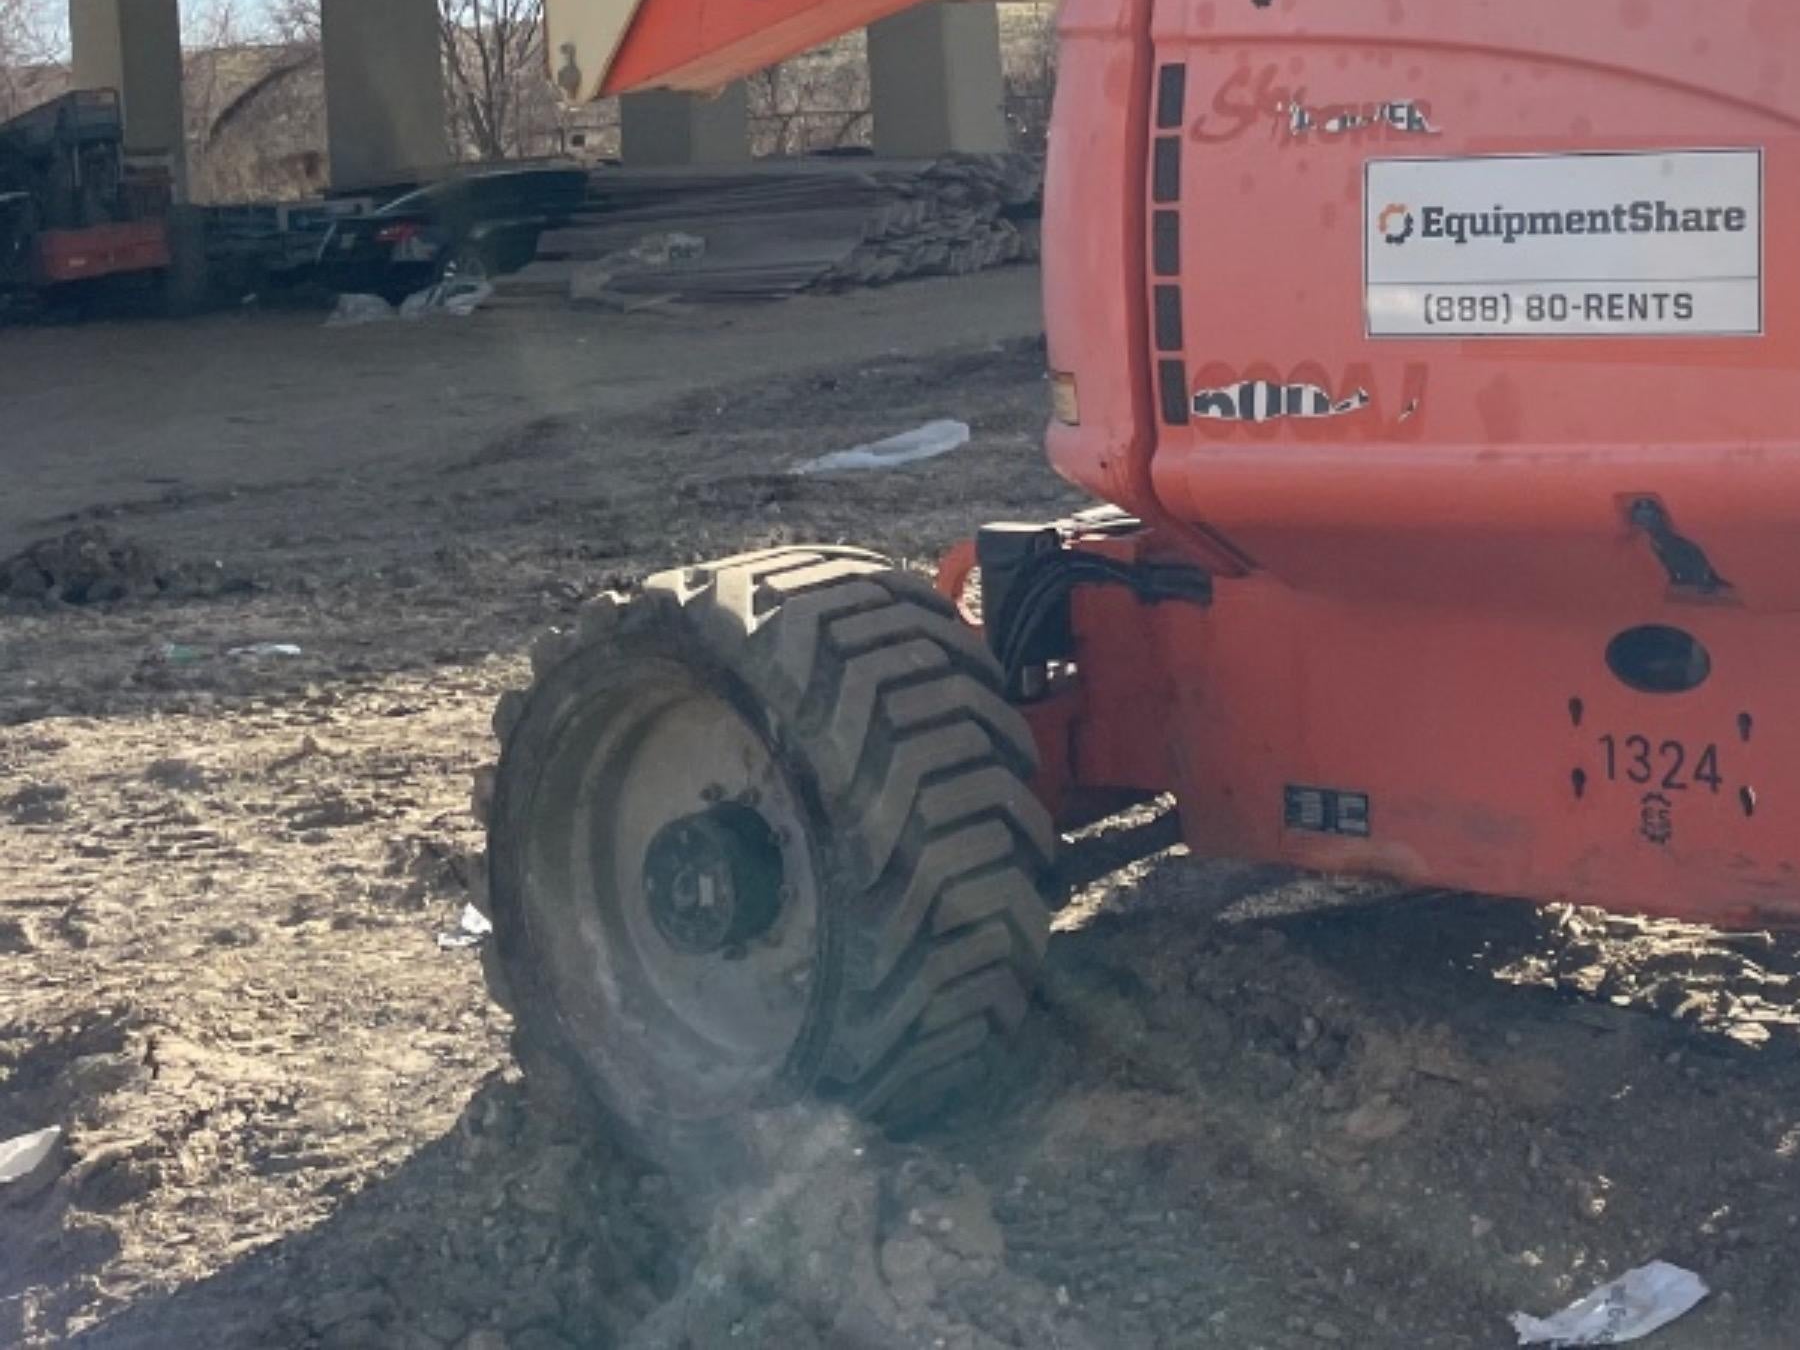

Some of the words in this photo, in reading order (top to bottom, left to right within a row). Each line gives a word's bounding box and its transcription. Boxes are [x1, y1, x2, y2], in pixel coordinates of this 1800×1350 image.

[1421, 201, 1746, 244] EquipmentShare
[1424, 292, 1512, 325] (888)
[1526, 292, 1694, 322] 80-RENTS
[1598, 733, 1723, 794] 1324
